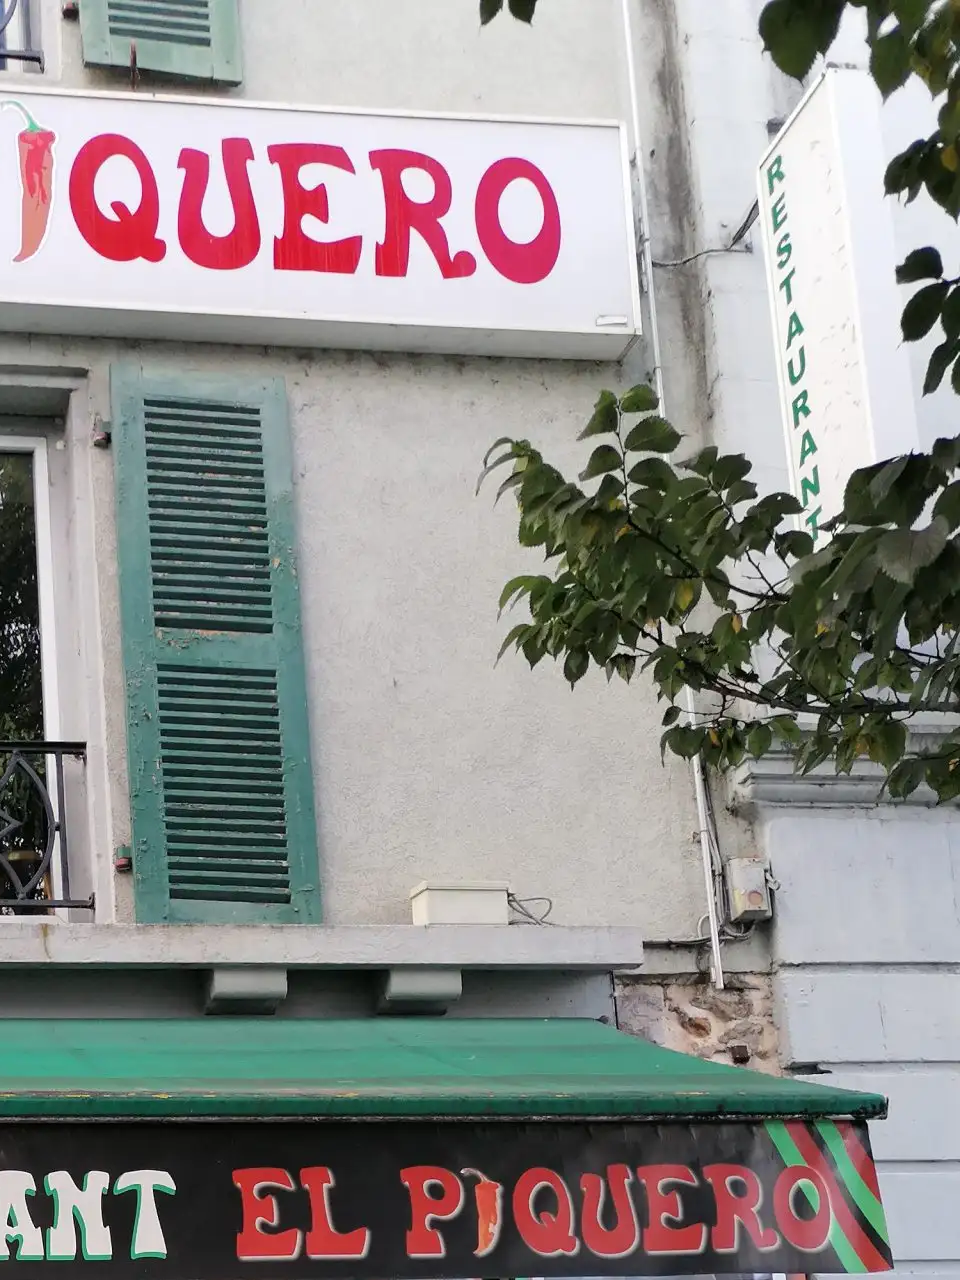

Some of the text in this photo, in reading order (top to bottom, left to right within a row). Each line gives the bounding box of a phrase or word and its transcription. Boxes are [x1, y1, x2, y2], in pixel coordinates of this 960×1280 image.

[766, 153, 823, 541] RESTAURANT
[232, 1165, 372, 1261] EL
[400, 1163, 837, 1260] PIQUERO
